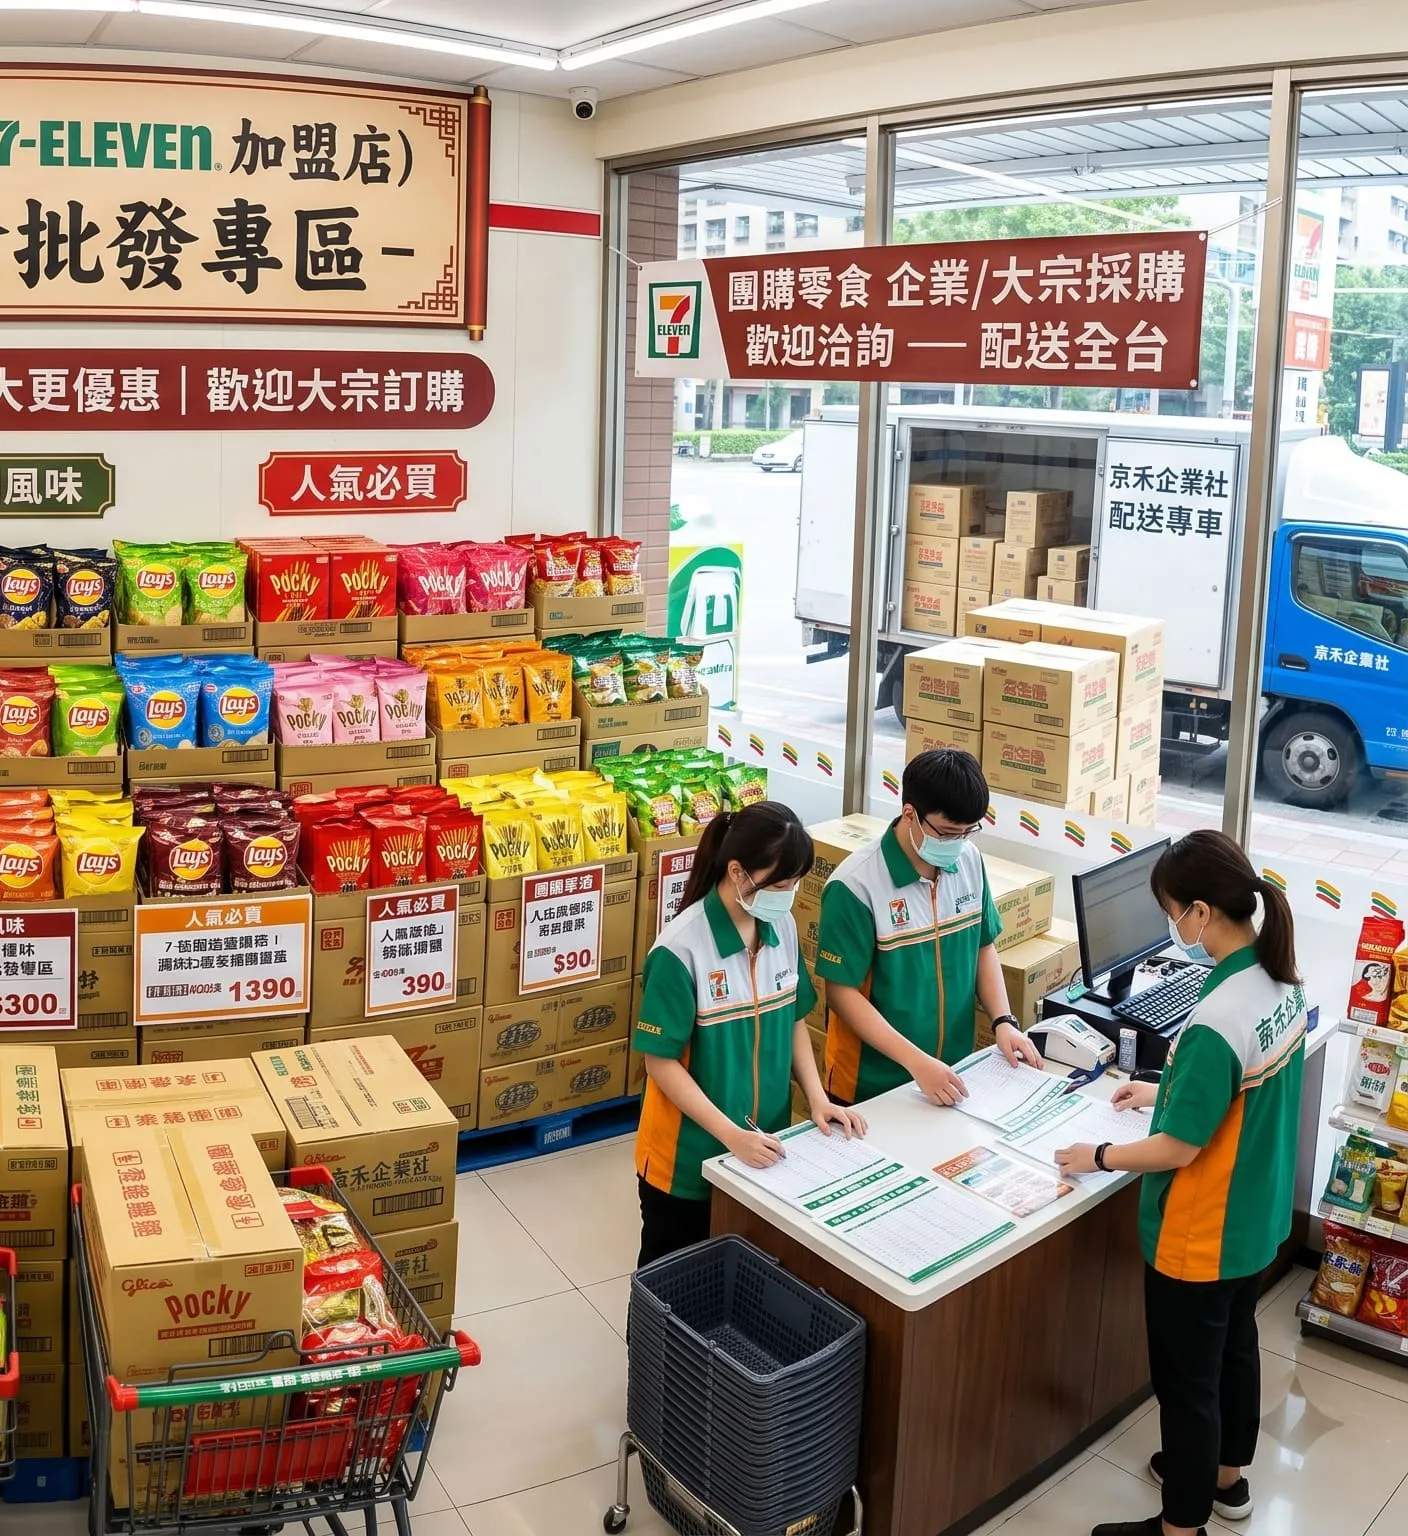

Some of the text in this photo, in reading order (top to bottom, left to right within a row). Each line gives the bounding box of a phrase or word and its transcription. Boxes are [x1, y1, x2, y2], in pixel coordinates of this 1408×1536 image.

[728, 263, 873, 312] 團購零食
[745, 322, 895, 368] 歡迎洽詢
[980, 319, 1168, 372] 配送全台
[206, 367, 465, 414] 歡迎大宗訂購
[290, 463, 438, 502] 人氣必買
[1109, 462, 1230, 499] 京禾企業社
[1108, 500, 1224, 539] 配送專車
[553, 948, 592, 975] $90
[228, 976, 296, 1002] 1390
[401, 971, 446, 996] 390
